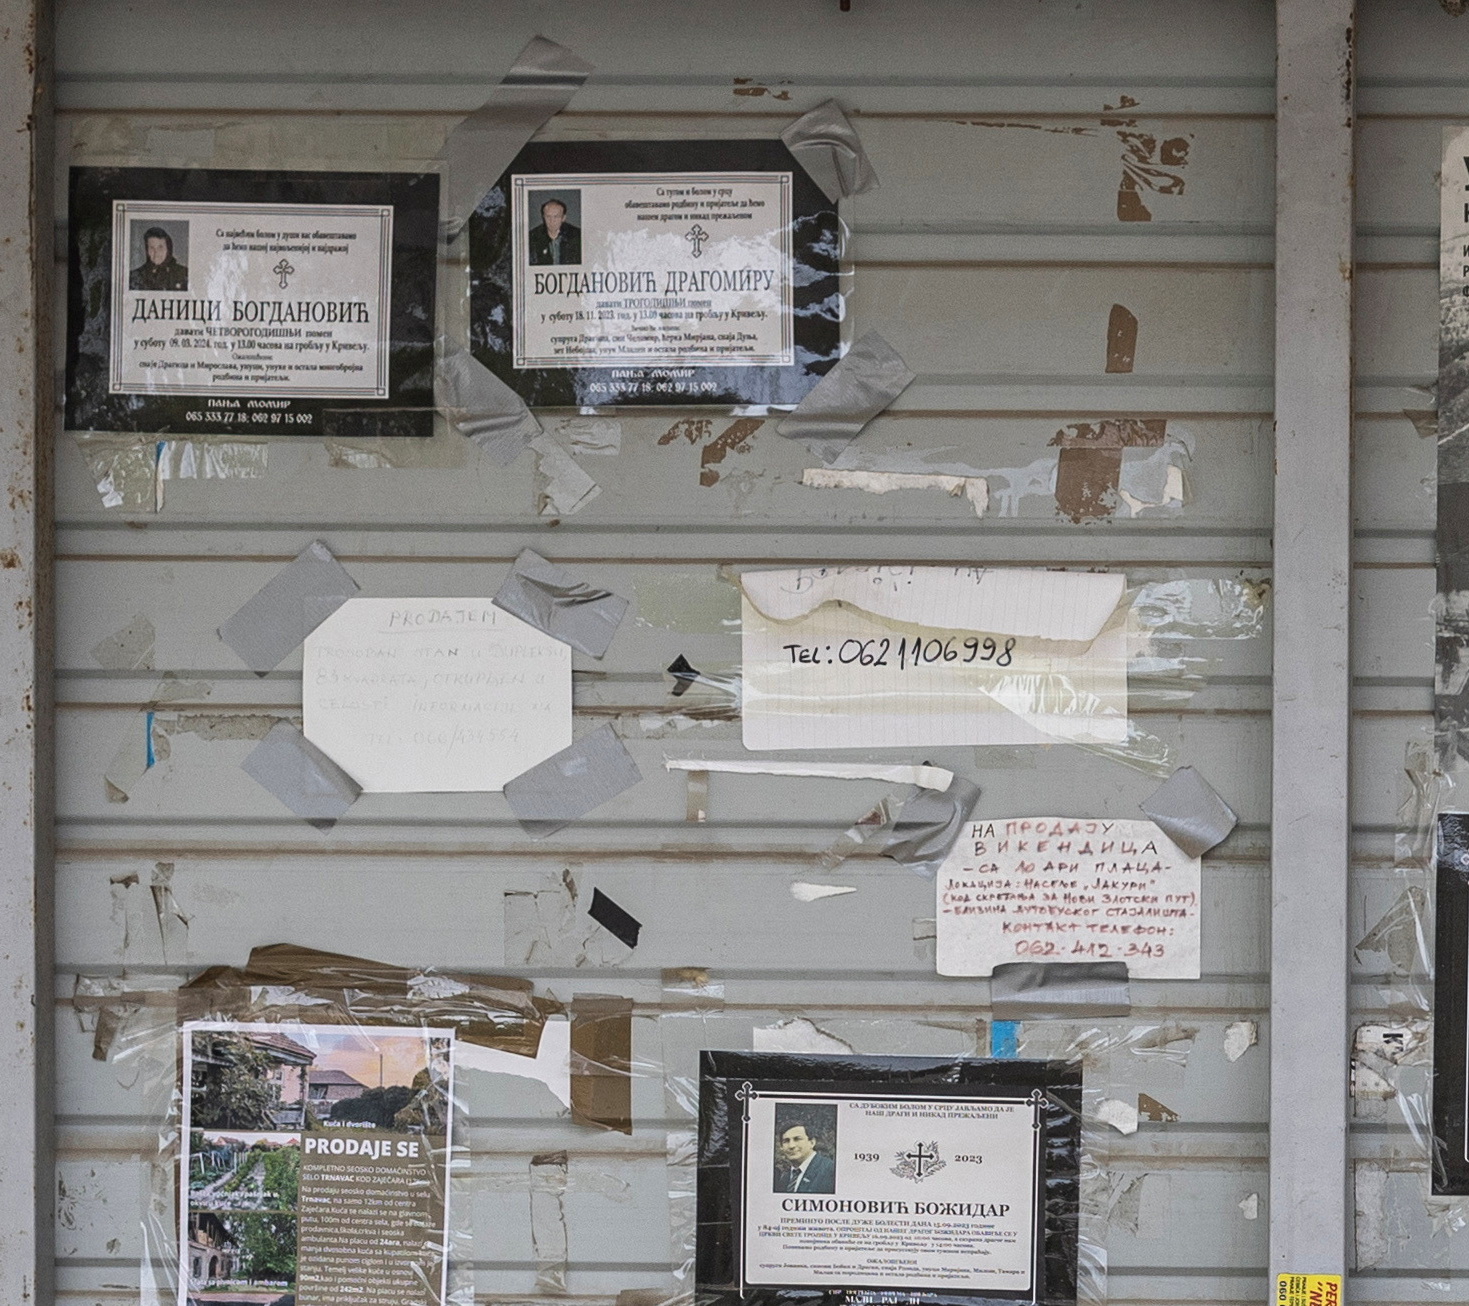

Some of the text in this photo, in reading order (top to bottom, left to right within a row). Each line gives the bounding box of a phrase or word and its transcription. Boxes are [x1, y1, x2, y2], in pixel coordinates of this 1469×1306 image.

[534, 270, 774, 296] БОГДАНОВИЋ ДРАГОМИРУ
[132, 299, 369, 325] ДАНИЦИ БОГДАНОВИЋ
[972, 822, 1114, 838] НА ПРОДАЈУ
[974, 841, 1158, 856] ВИКЕНДИЦА
[305, 1138, 419, 1159] PRODAJE SE
[782, 1198, 1010, 1218] СИМОНОВИЋ БОЖИДАР
[1279, 1281, 1287, 1300] 060
